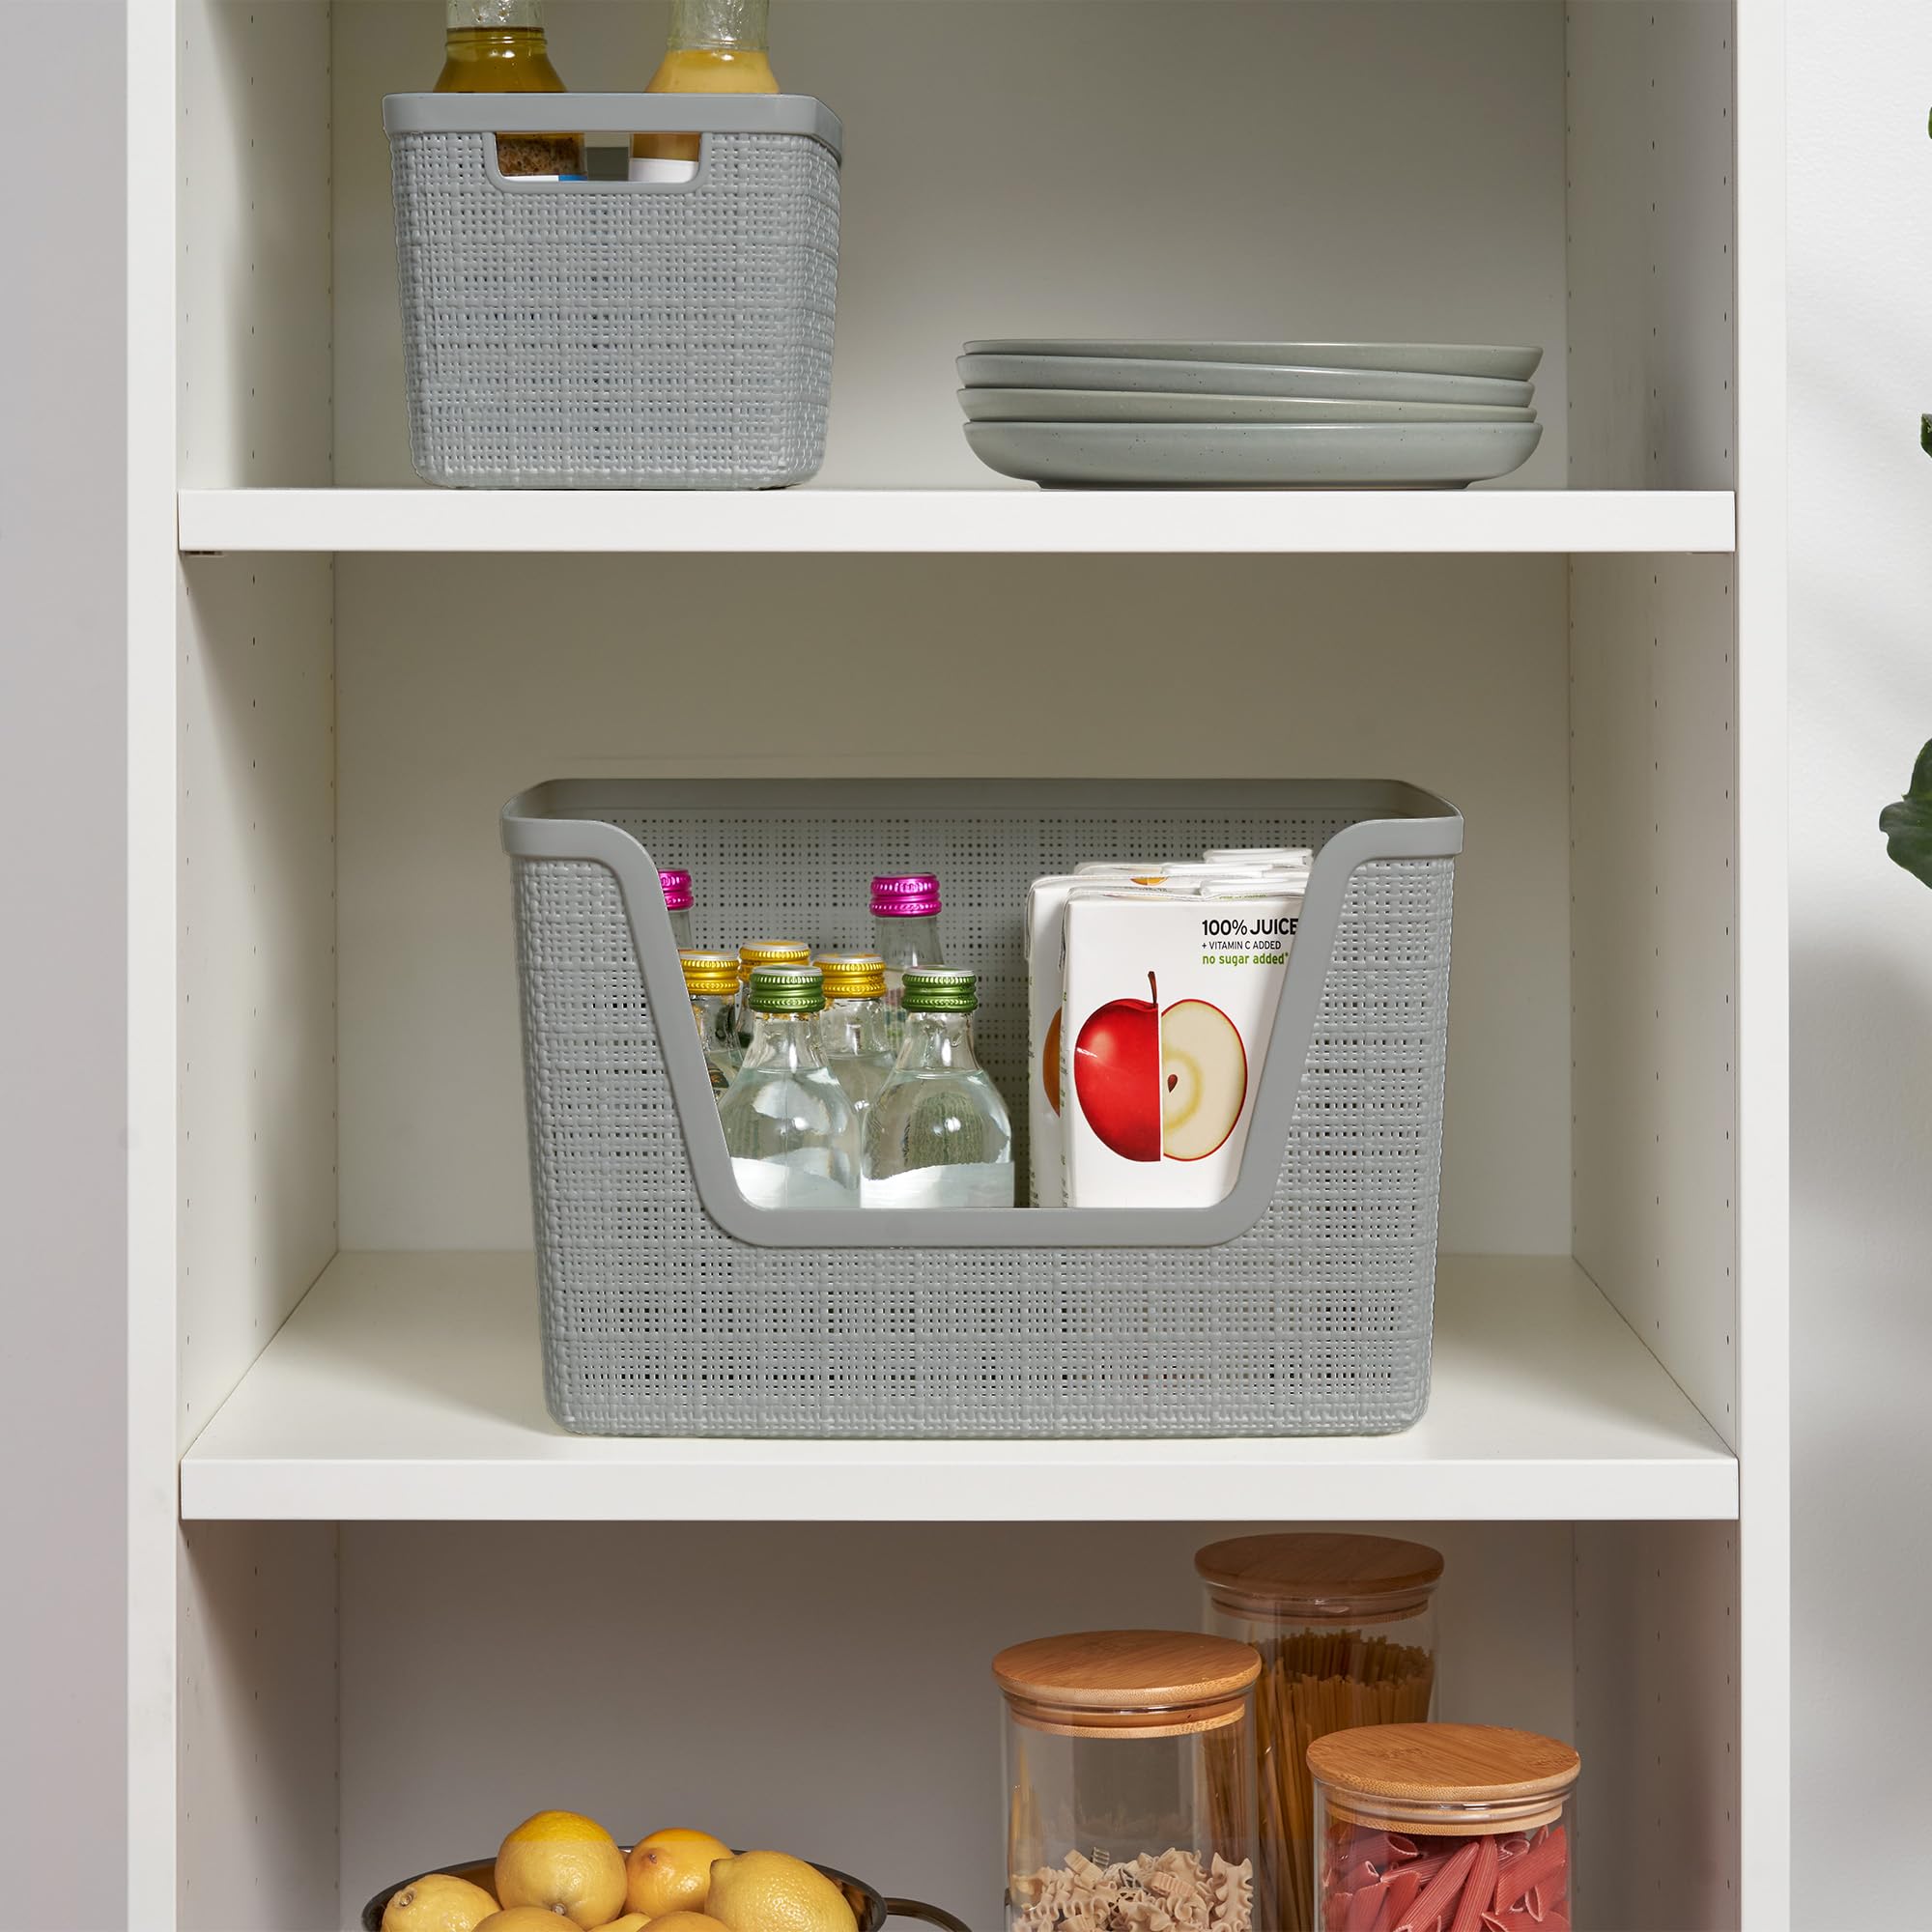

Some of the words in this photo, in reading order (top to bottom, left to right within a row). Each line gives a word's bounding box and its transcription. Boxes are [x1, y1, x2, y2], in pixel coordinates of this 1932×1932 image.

[1202, 919, 1248, 936] 100%
[1250, 918, 1298, 935] JUICE
[1208, 941, 1243, 950] VITAMIN
[1244, 941, 1251, 950] C
[1252, 940, 1281, 950] ADDED
[1202, 954, 1216, 965] no
[1218, 954, 1250, 967] sugar
